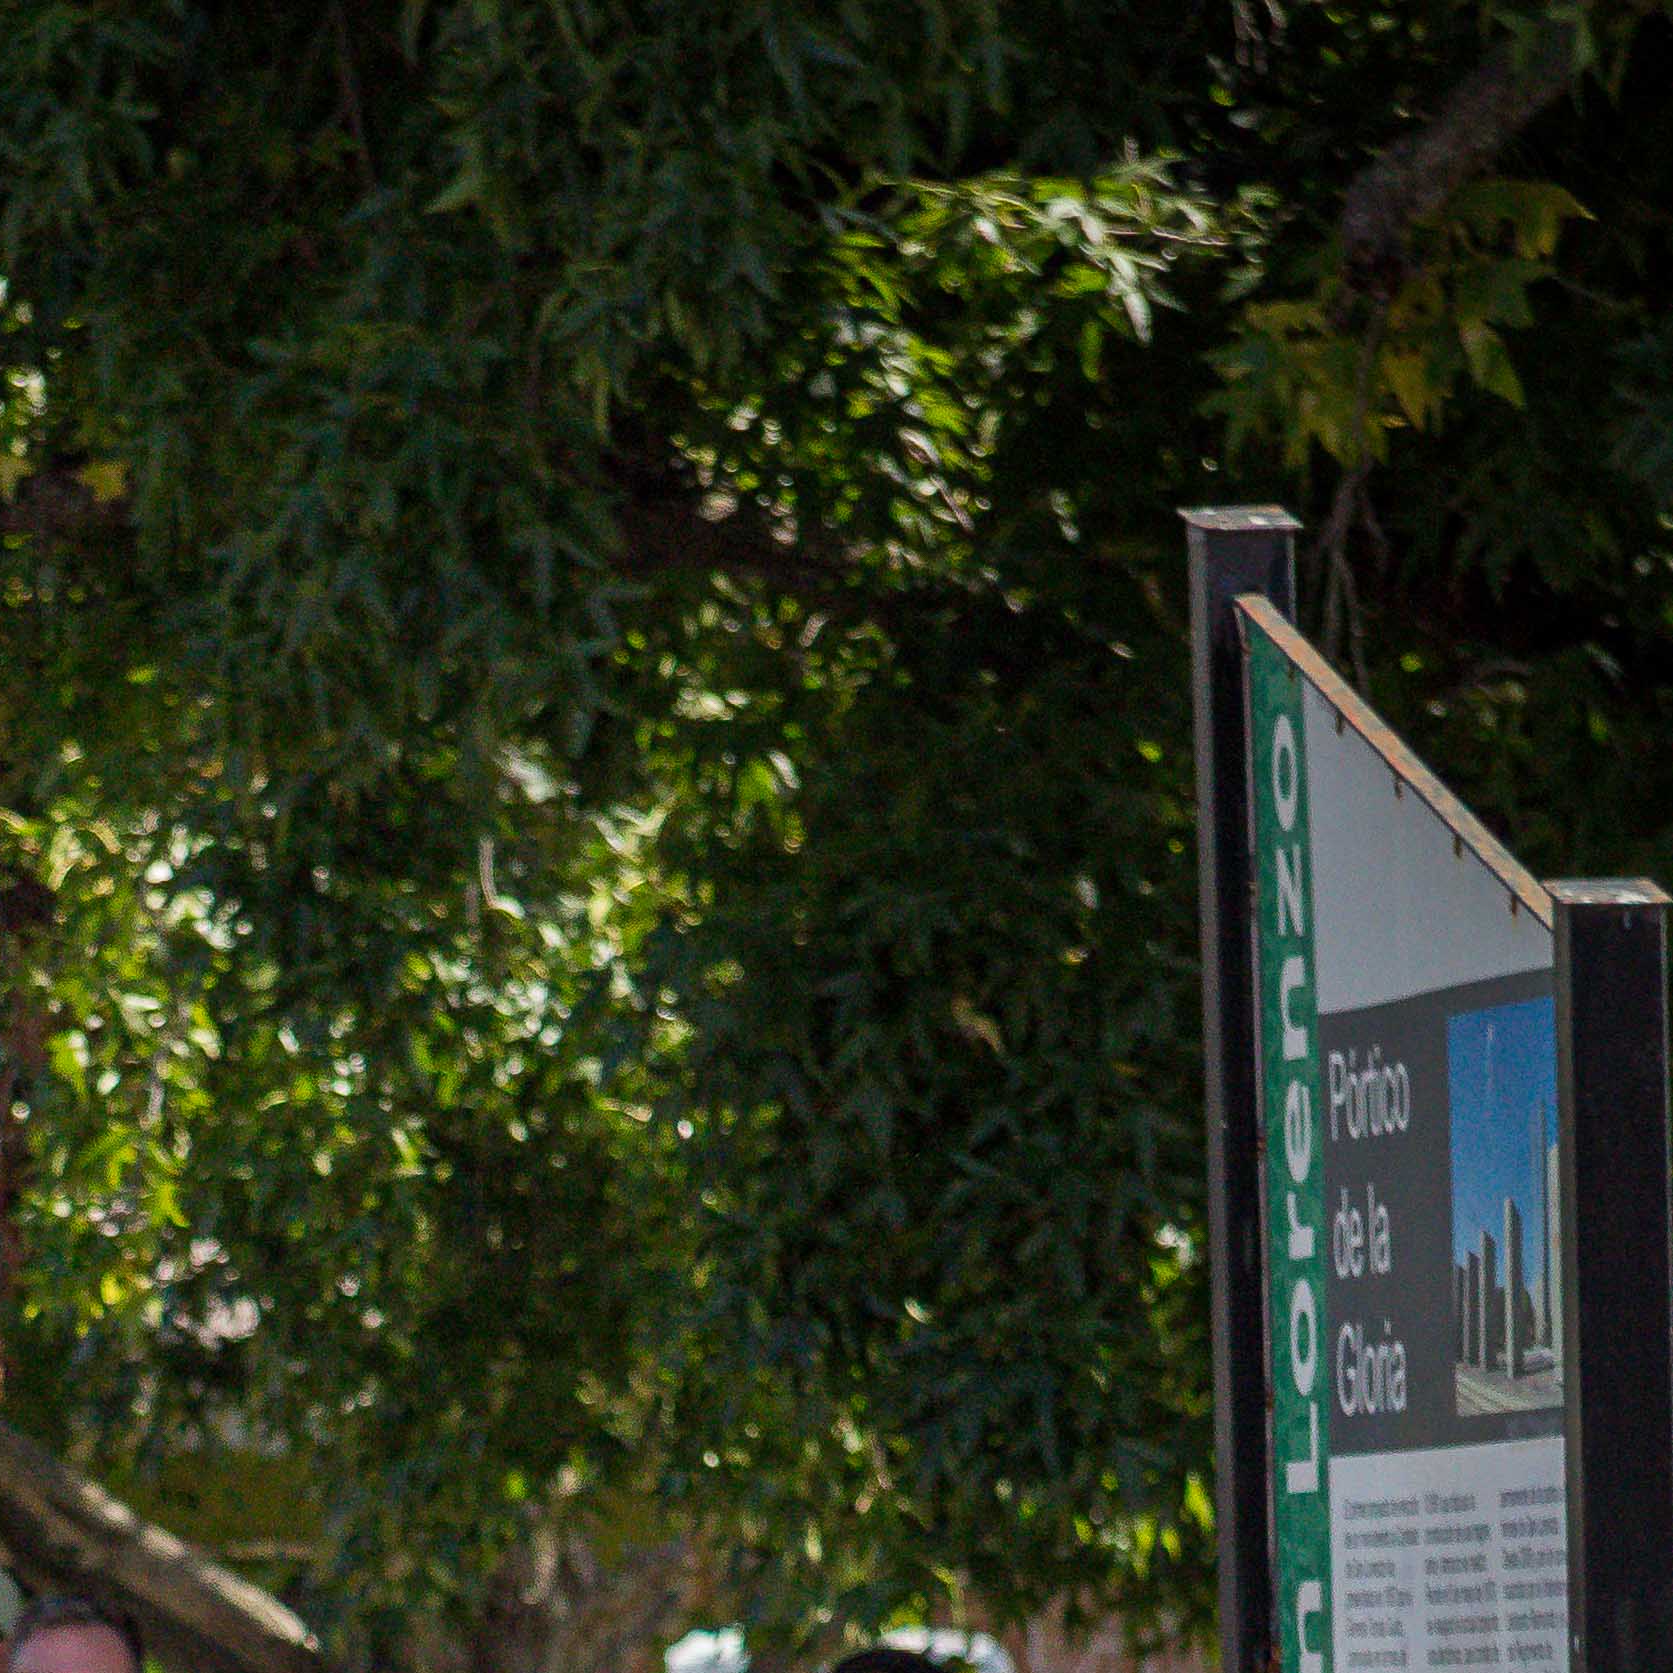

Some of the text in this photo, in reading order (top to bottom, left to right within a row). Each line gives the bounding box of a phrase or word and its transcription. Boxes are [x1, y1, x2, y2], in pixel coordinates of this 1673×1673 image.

[1271, 713, 1319, 1494] Lorenzo
[1329, 1043, 1410, 1141] Pórtico
[1333, 1181, 1391, 1279] de la
[1336, 1317, 1407, 1417] Gloria
